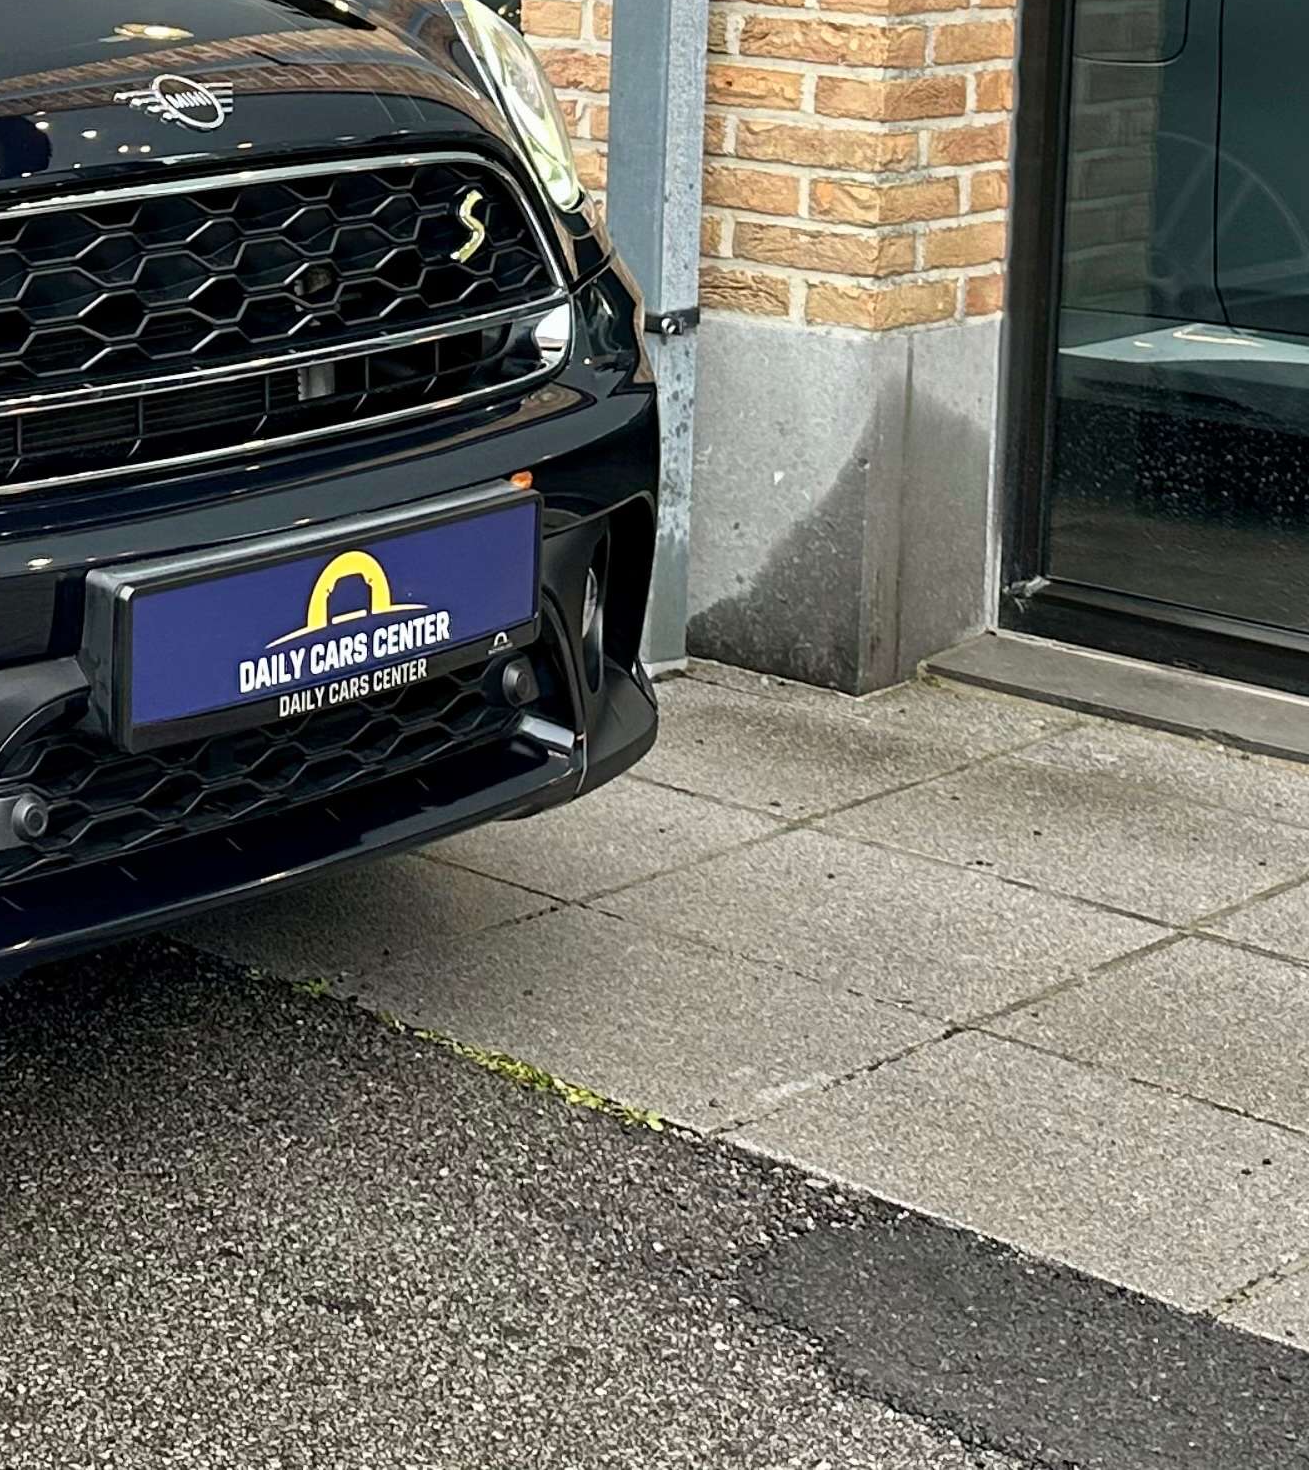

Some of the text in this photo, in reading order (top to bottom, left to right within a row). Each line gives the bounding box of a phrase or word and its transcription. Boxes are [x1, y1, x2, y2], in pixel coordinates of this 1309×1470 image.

[165, 91, 213, 109] MINI
[449, 189, 486, 263] S
[239, 611, 451, 693] DAILY CARS CENTER
[279, 658, 427, 718] DAILY CARS CENTER
